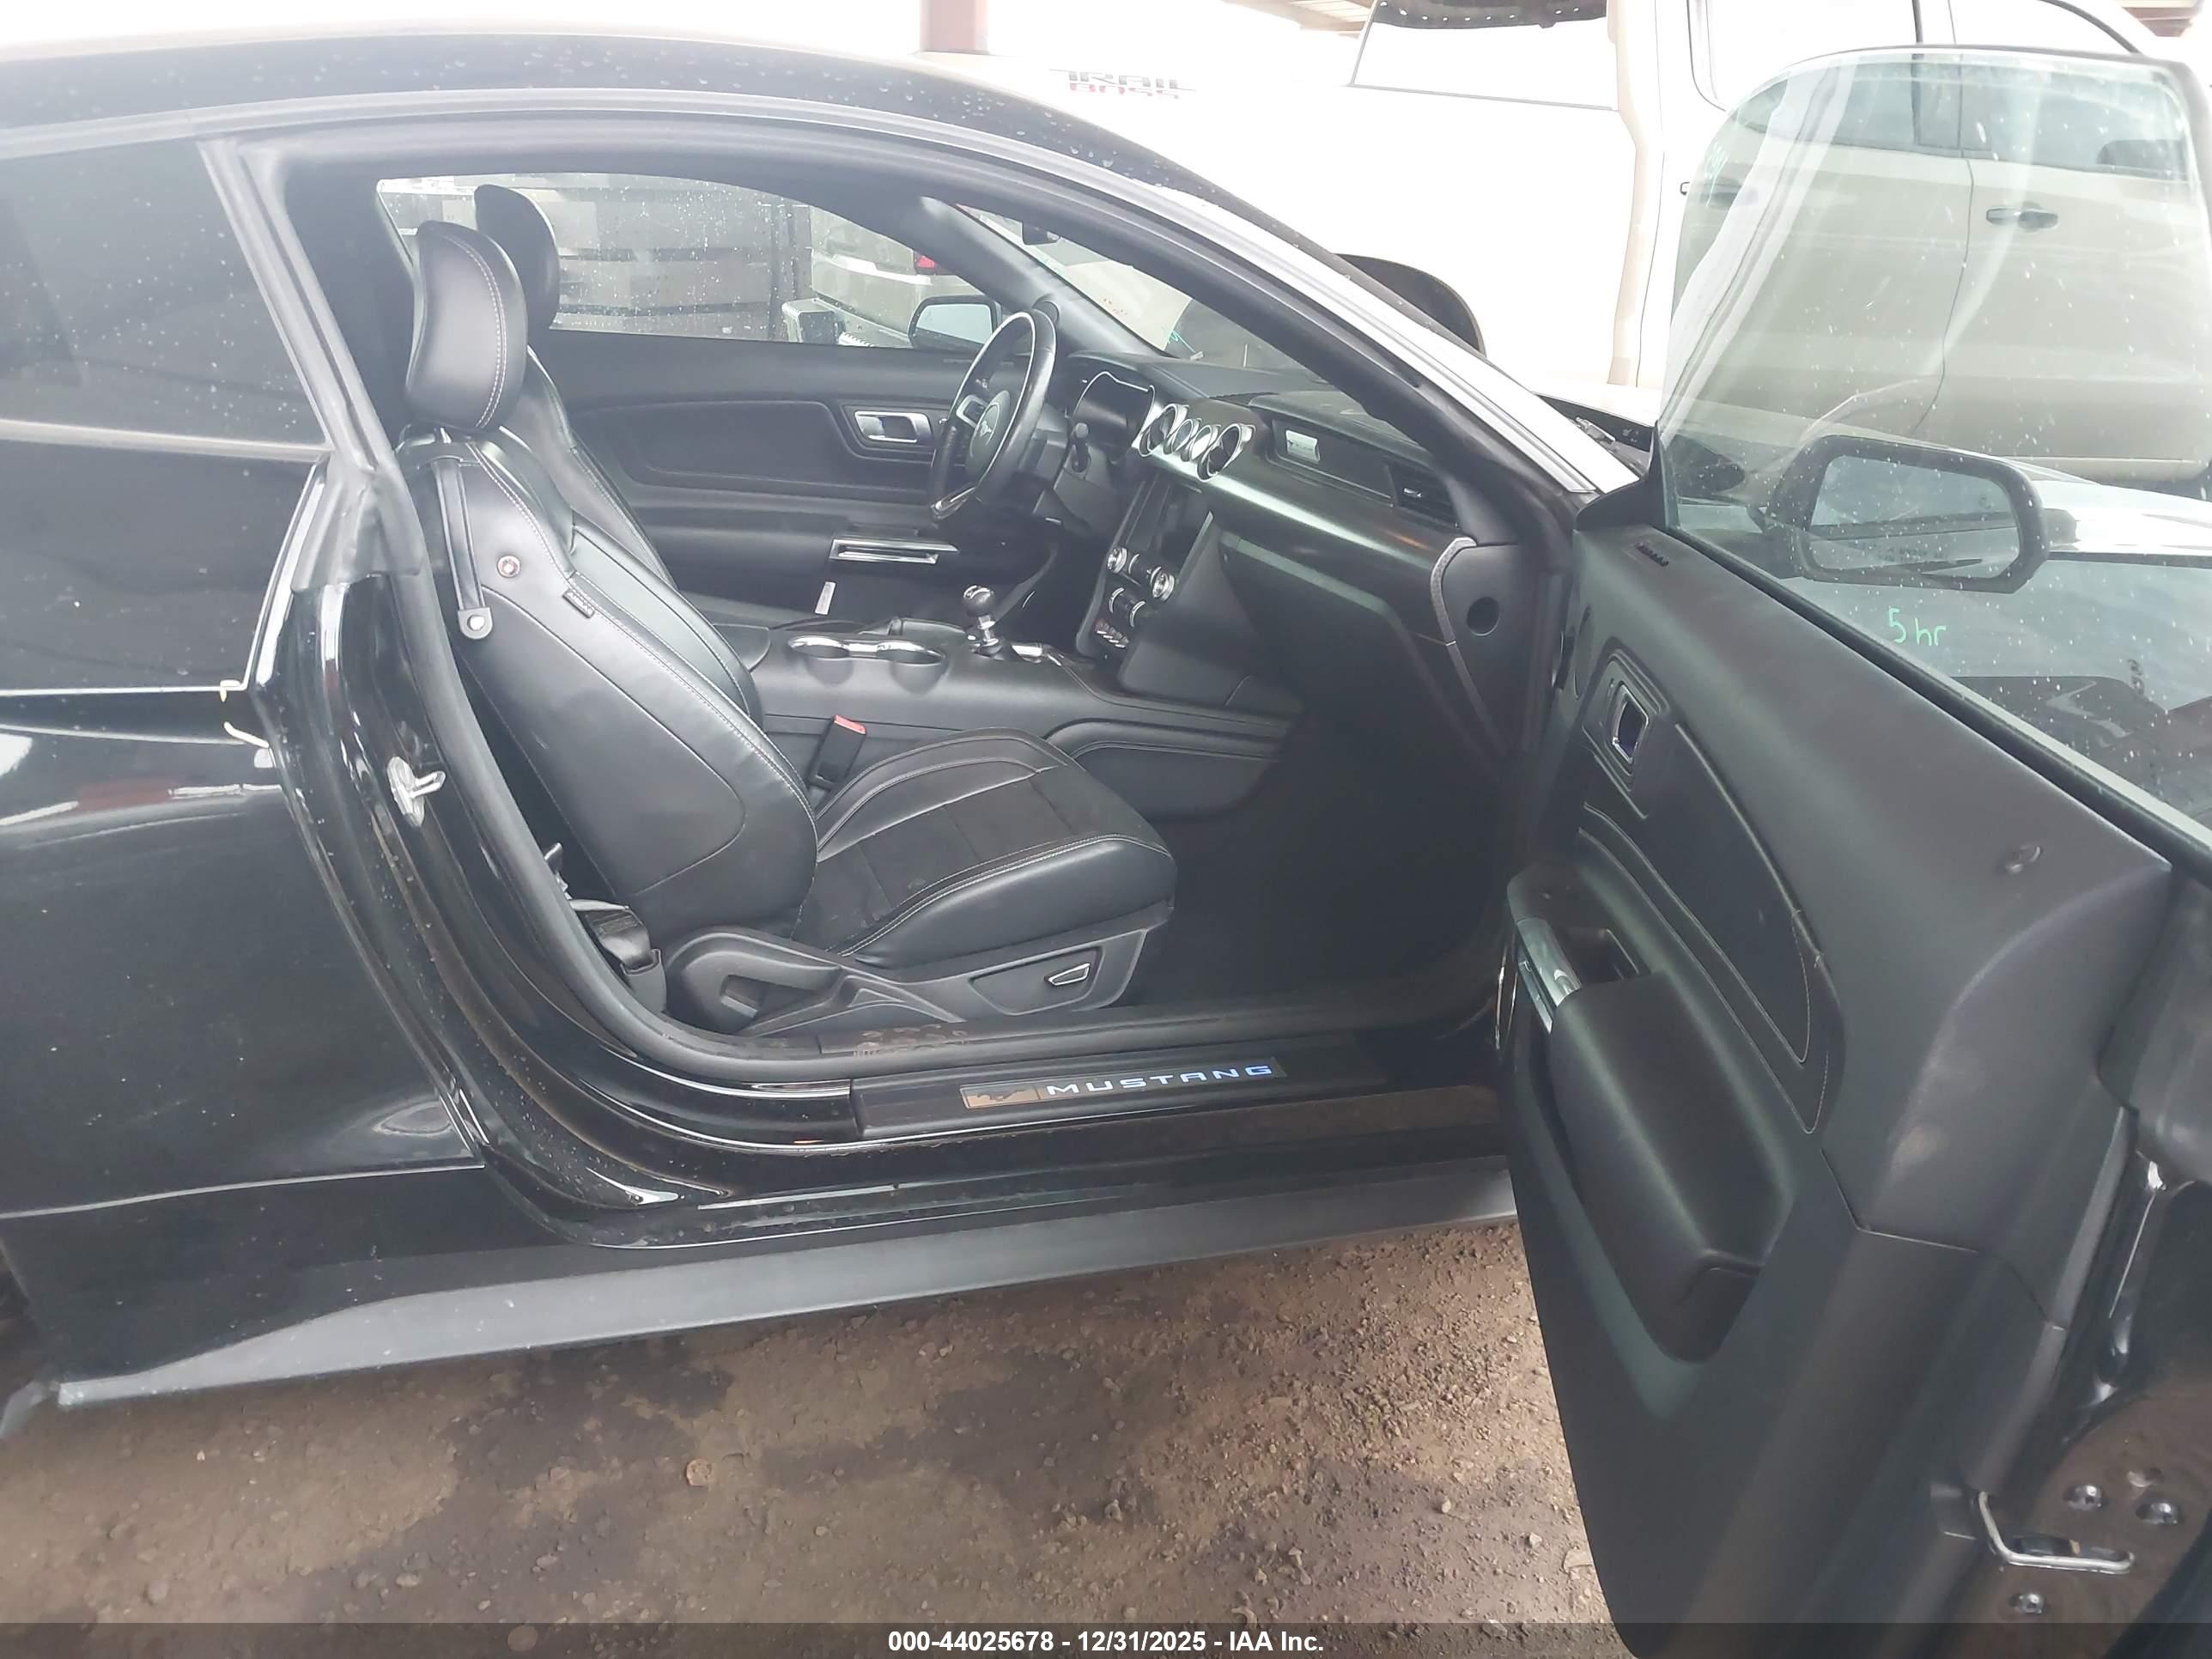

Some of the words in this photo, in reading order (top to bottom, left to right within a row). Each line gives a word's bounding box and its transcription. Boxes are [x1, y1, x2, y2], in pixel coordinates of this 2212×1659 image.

[1888, 606, 1907, 643] 5
[1914, 617, 1947, 647] hr
[1047, 1065, 1272, 1096] MUSTANG
